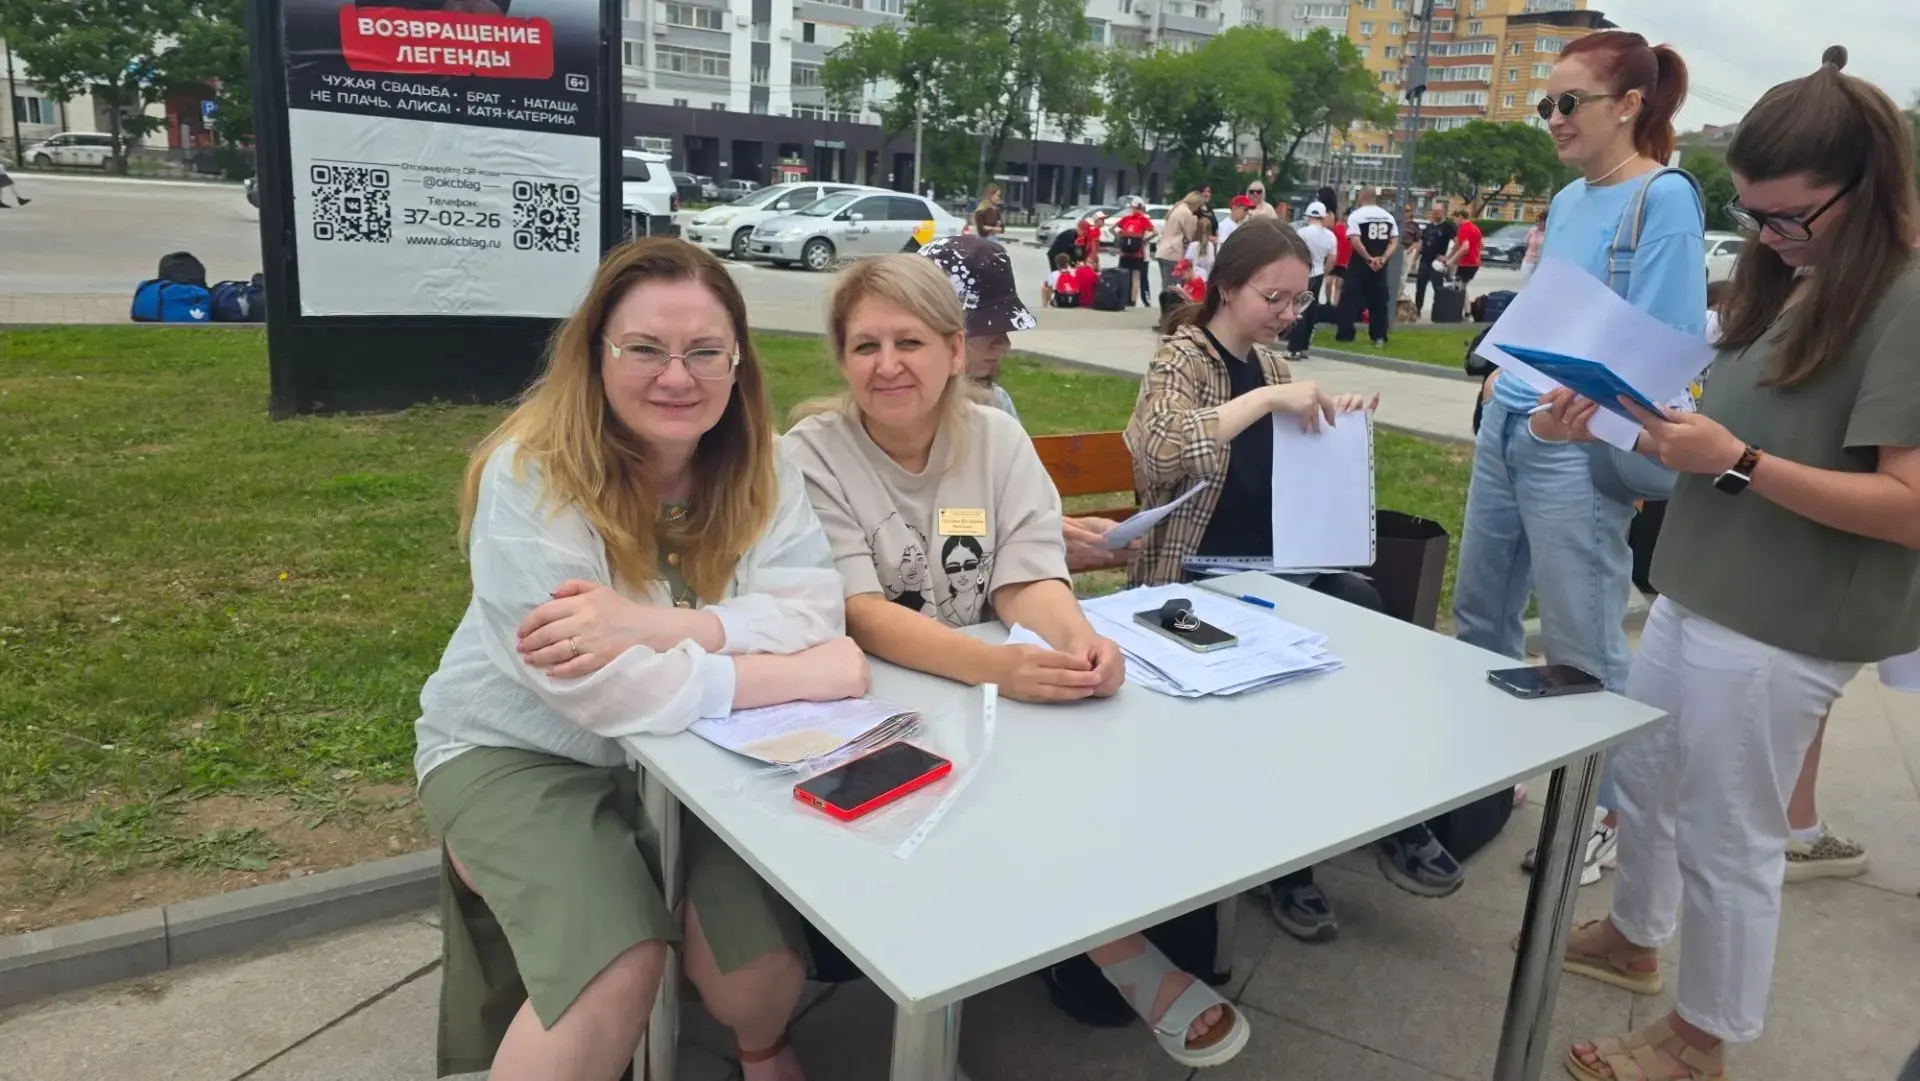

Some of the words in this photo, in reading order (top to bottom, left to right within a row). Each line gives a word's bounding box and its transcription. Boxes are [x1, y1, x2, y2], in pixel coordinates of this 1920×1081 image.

[357, 17, 542, 44] ВОЗВРАЩЕНИЕ
[396, 45, 511, 68] ЛЕГЕНДЫ
[570, 77, 585, 88] 6+
[322, 74, 376, 90] ЧУЖАЯ
[381, 80, 450, 98] СВАДЬБА
[466, 91, 501, 104] БРАТ
[523, 97, 579, 112] НАТАША
[310, 90, 332, 102] НЕ
[467, 105, 576, 126] КАТЯ-КАТЕРИНА
[423, 176, 481, 192] @okcblag
[404, 208, 501, 228] 37-02-26
[1368, 222, 1389, 240] 82
[406, 236, 502, 249] www.okcblag.ru
